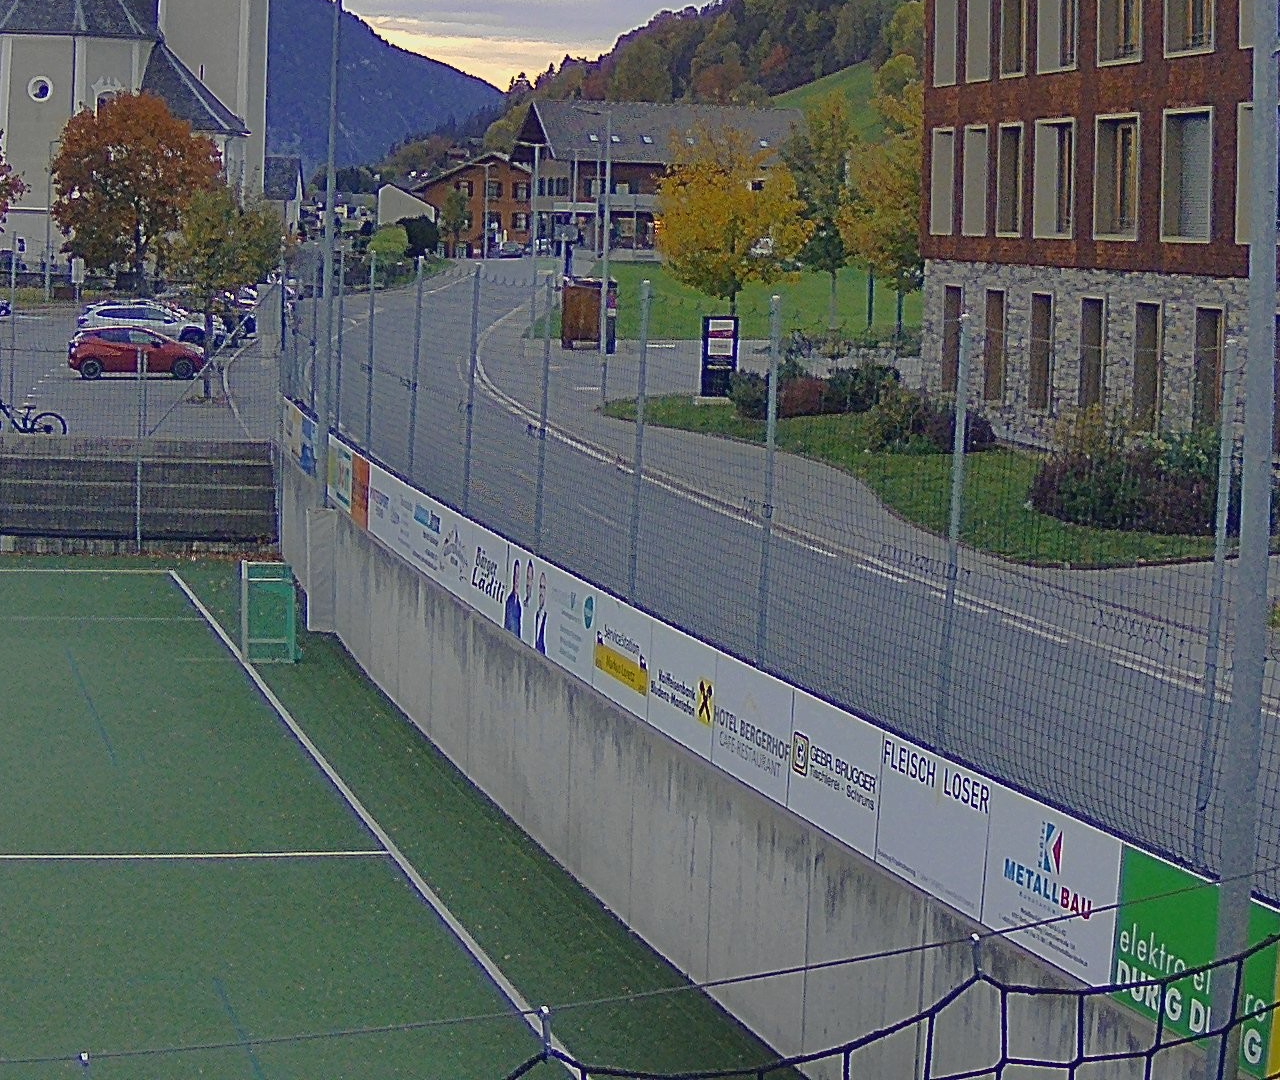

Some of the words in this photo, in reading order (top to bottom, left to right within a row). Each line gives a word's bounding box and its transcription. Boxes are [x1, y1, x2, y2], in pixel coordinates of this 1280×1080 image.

[658, 669, 696, 701] Raiffeisenbank
[713, 705, 738, 734] HOTEL
[740, 719, 791, 761] BERGERHOF
[810, 745, 834, 771] GEBR.
[809, 764, 840, 792] Tischlerei
[883, 740, 937, 788] FLEISCH
[943, 768, 990, 814] LOSER
[1003, 858, 1092, 920] METALLBAU
[1120, 923, 1186, 980] elektro
